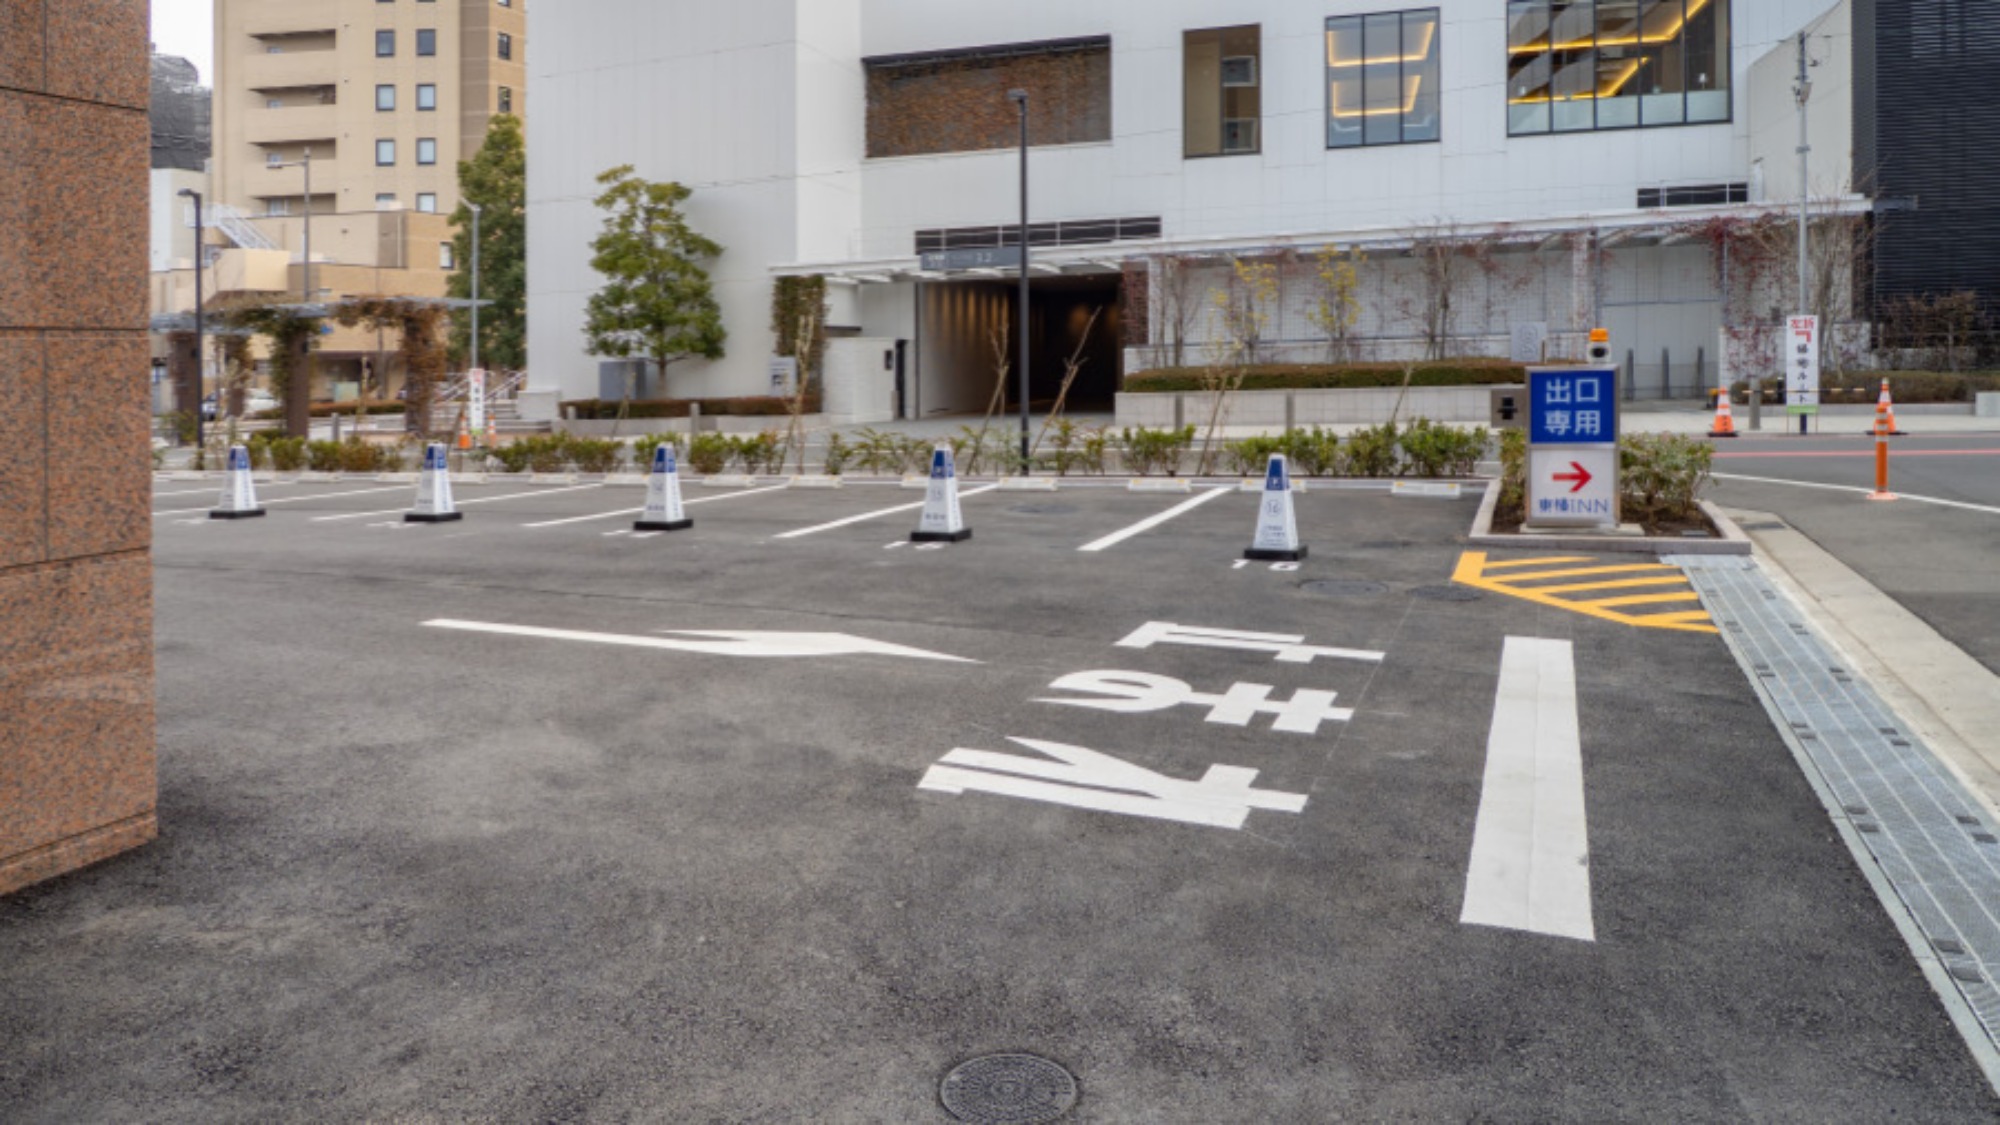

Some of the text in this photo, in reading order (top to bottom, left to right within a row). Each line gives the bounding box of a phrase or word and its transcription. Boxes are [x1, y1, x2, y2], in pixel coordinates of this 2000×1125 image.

[1546, 377, 1600, 404] 出口
[1544, 410, 1601, 436] 専用
[917, 620, 1386, 830] 止まれ
